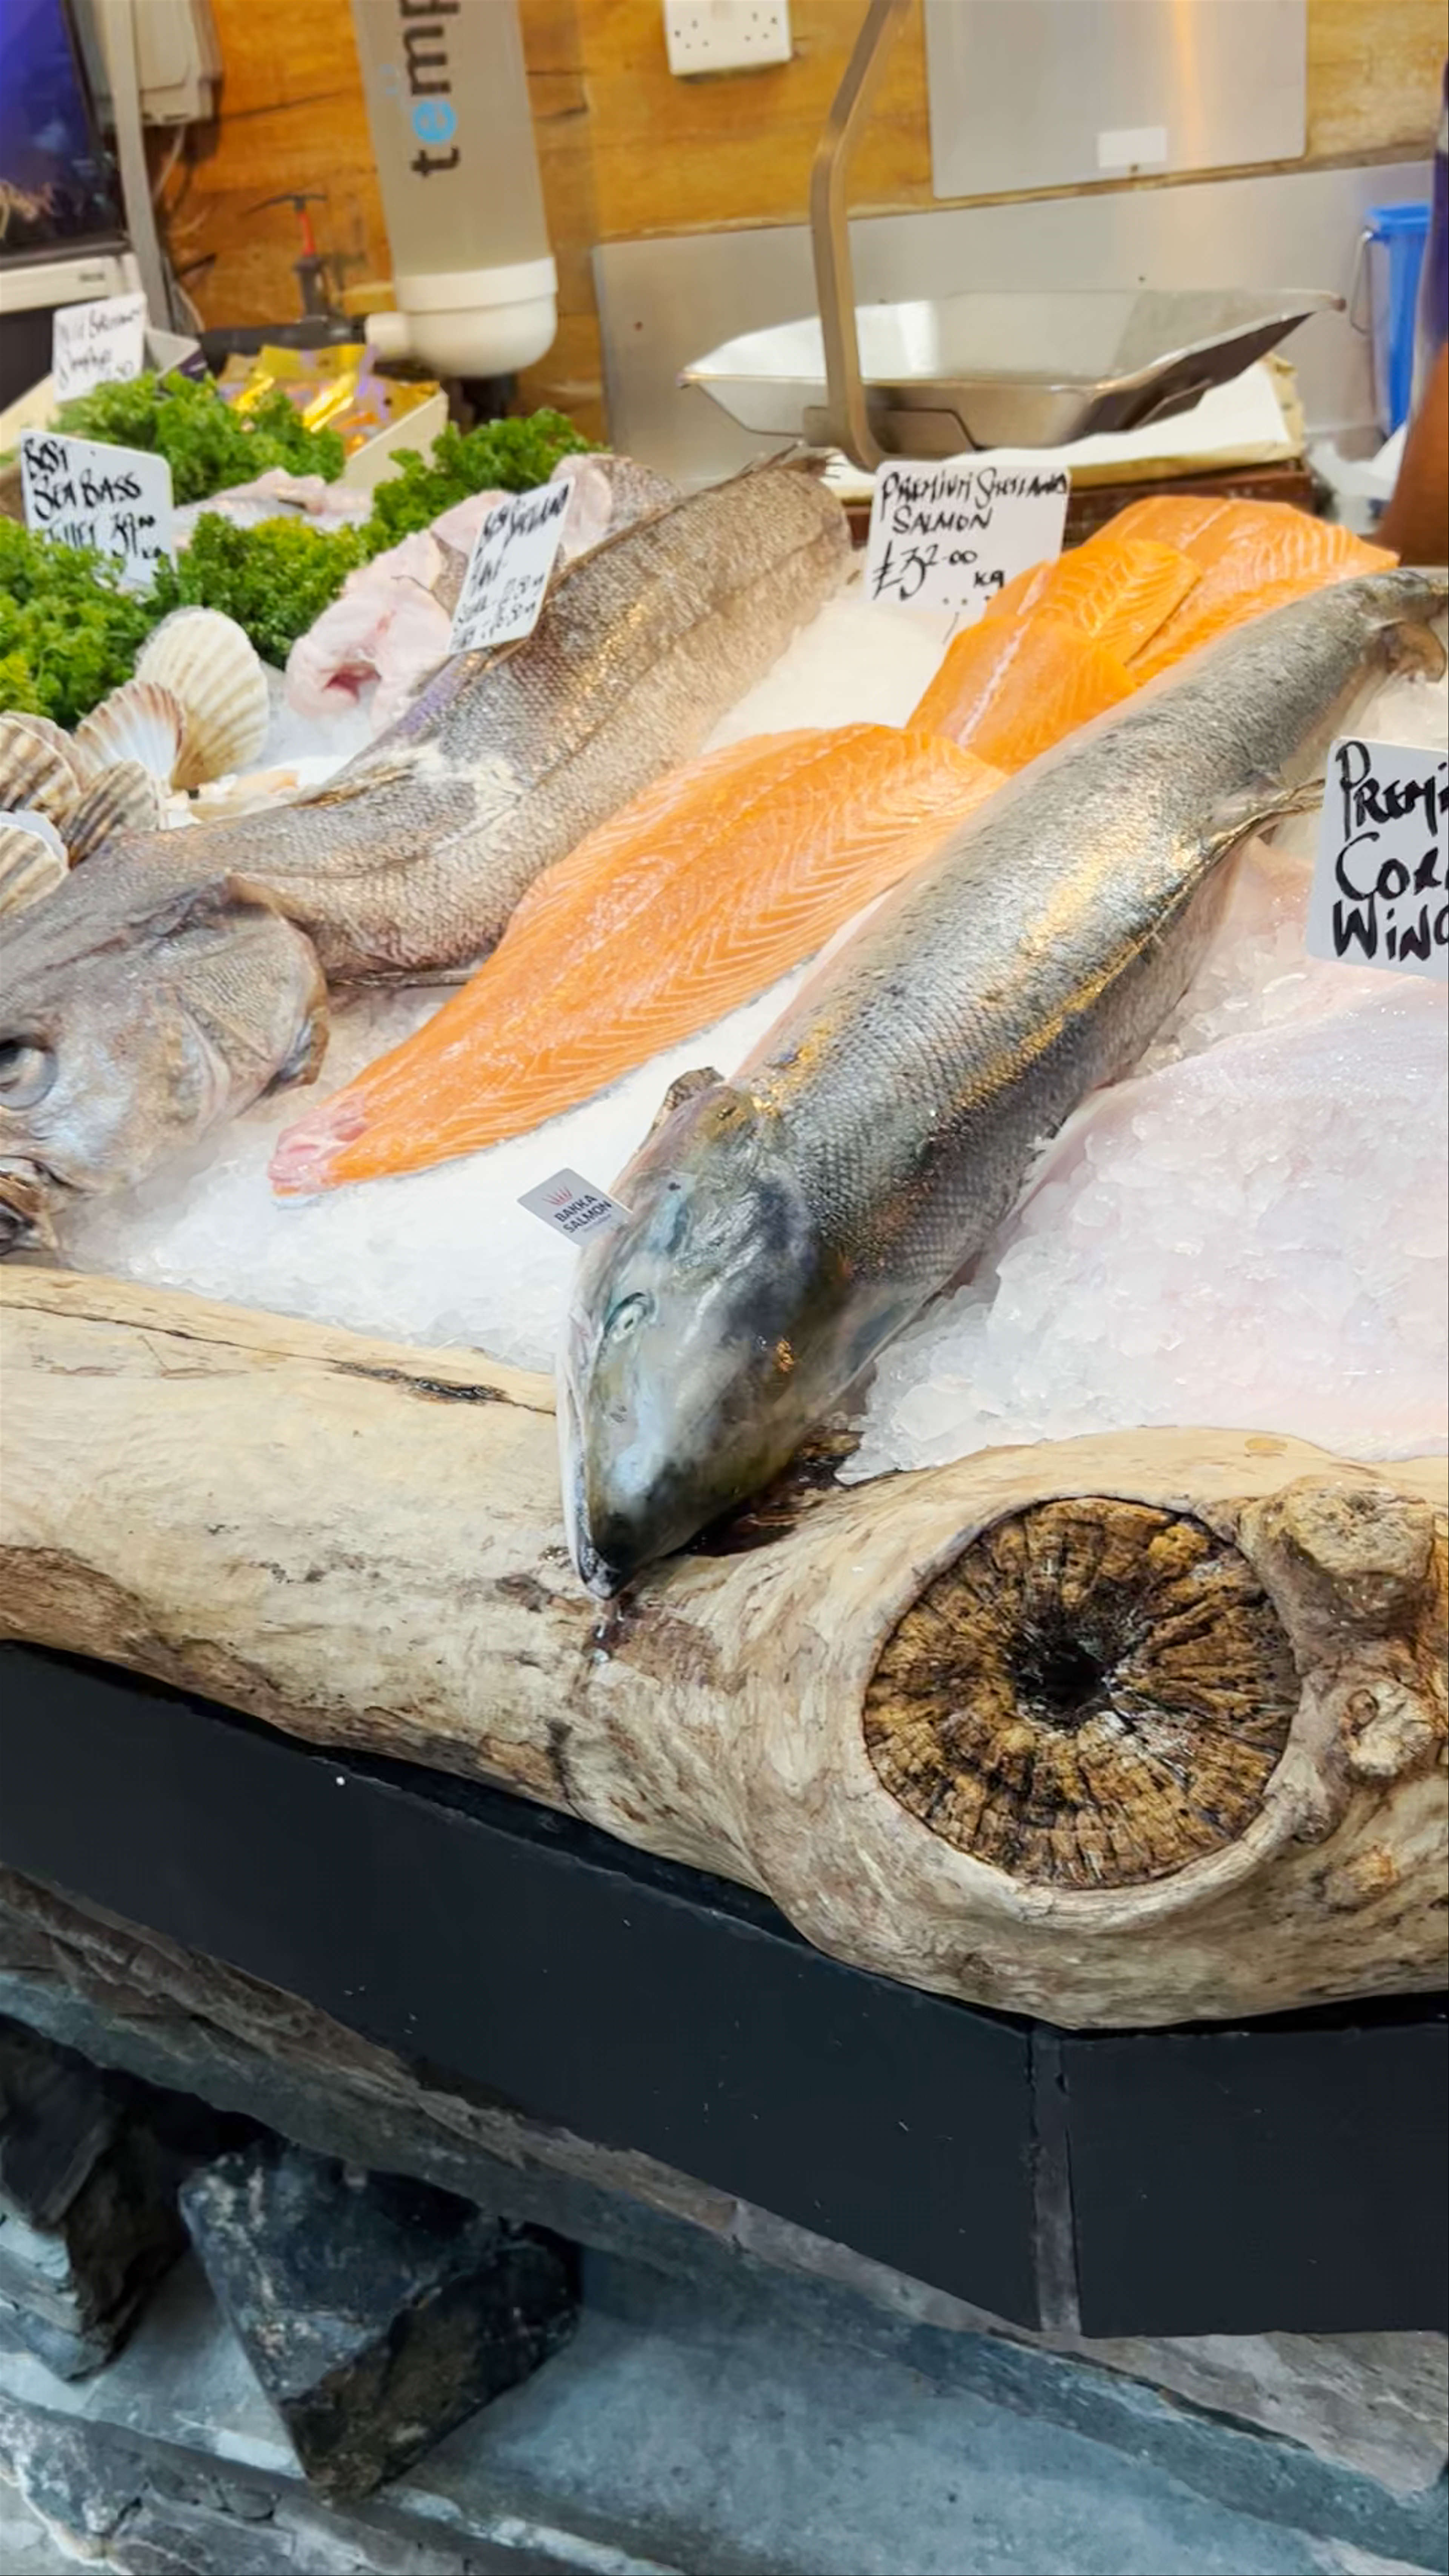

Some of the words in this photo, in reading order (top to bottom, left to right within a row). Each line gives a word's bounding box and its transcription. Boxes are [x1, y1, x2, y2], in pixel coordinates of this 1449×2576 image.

[34, 475, 77, 520] SEA
[80, 469, 142, 508] BASS
[892, 504, 994, 534] SALMON
[1335, 831, 1448, 902] COR
[554, 1195, 598, 1223] BAKKA
[563, 1200, 612, 1233] SALMON
